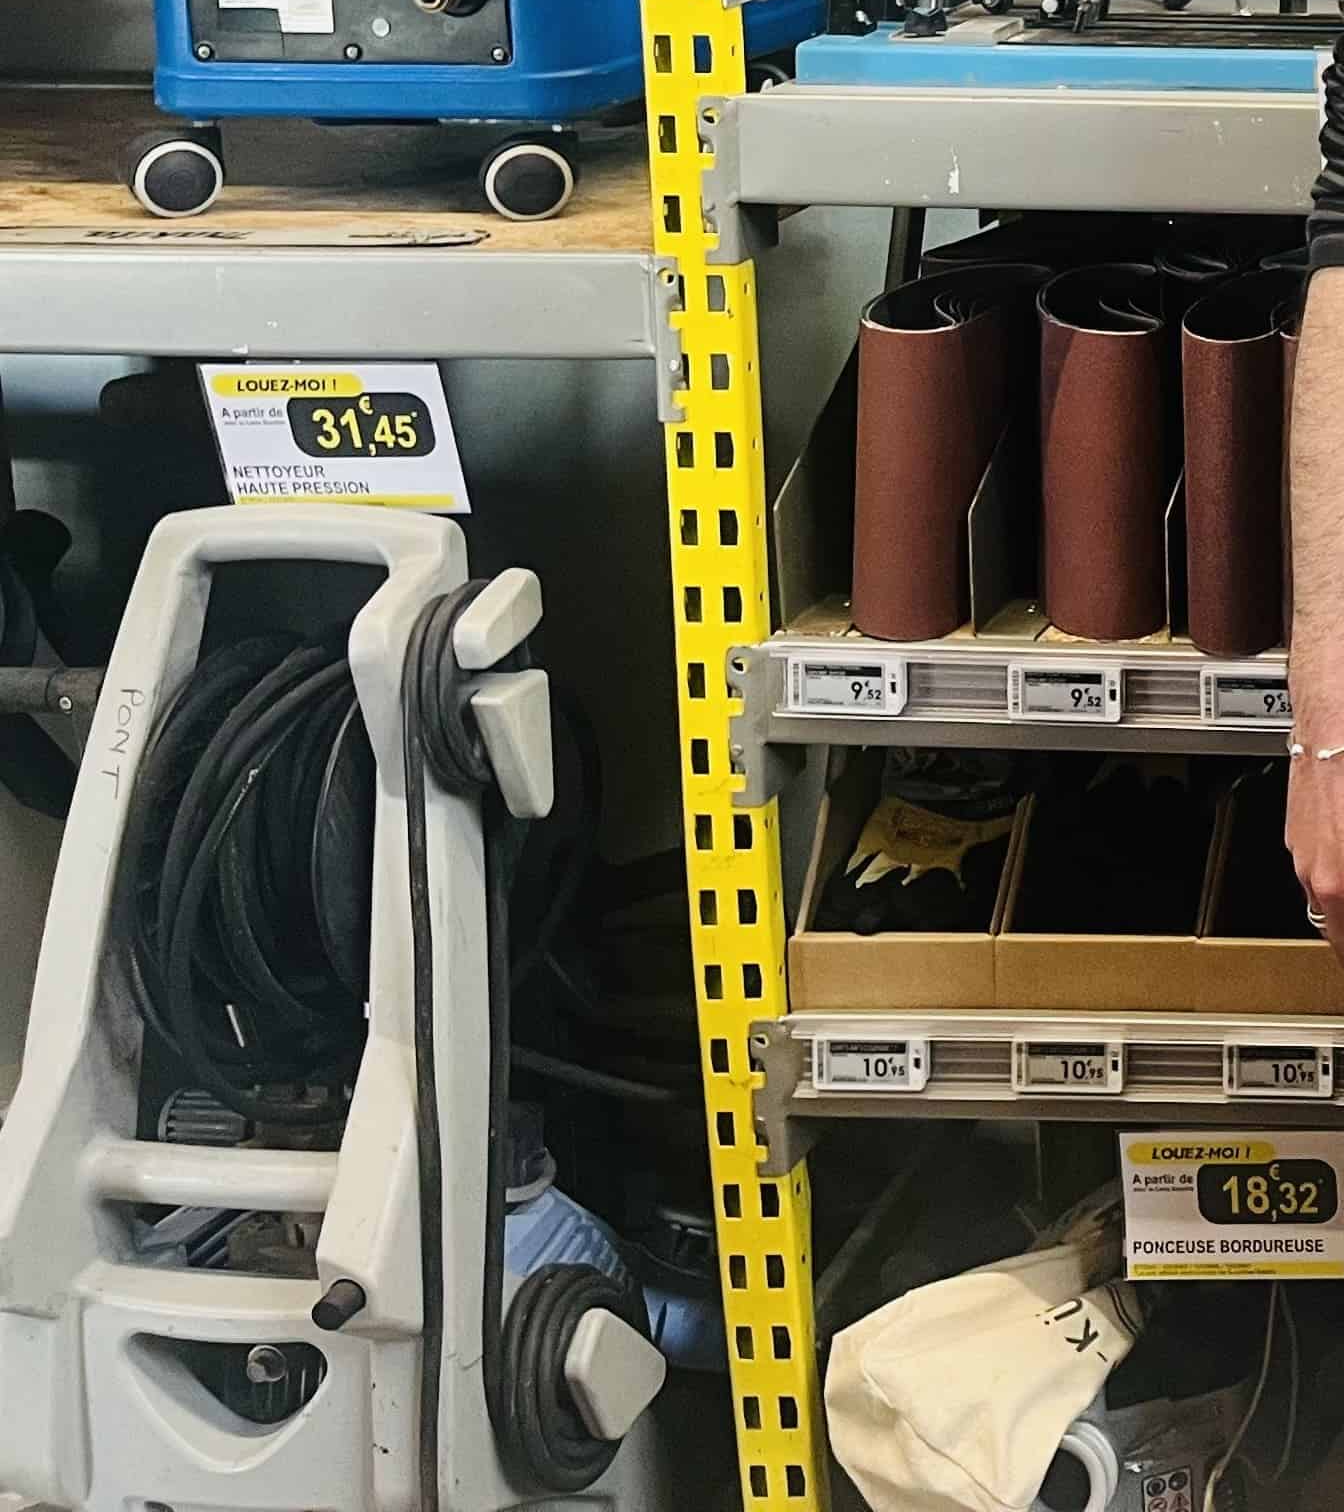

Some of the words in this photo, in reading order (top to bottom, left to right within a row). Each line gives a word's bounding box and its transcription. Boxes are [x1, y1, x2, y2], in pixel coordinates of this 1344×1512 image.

[237, 379, 327, 391] LOUEZ-MOI
[234, 408, 265, 419] partir
[269, 408, 283, 417] de
[233, 465, 325, 478] NETTOYEUR
[237, 482, 288, 494] HAUTE
[293, 482, 370, 494] PRESSION
[1152, 1148, 1240, 1160] LOUEZ-MOI
[1145, 1174, 1175, 1186] partir
[1179, 1173, 1193, 1184] de
[1133, 1241, 1216, 1253] PONCEUSE
[1220, 1240, 1324, 1252] BORDUREUSE
